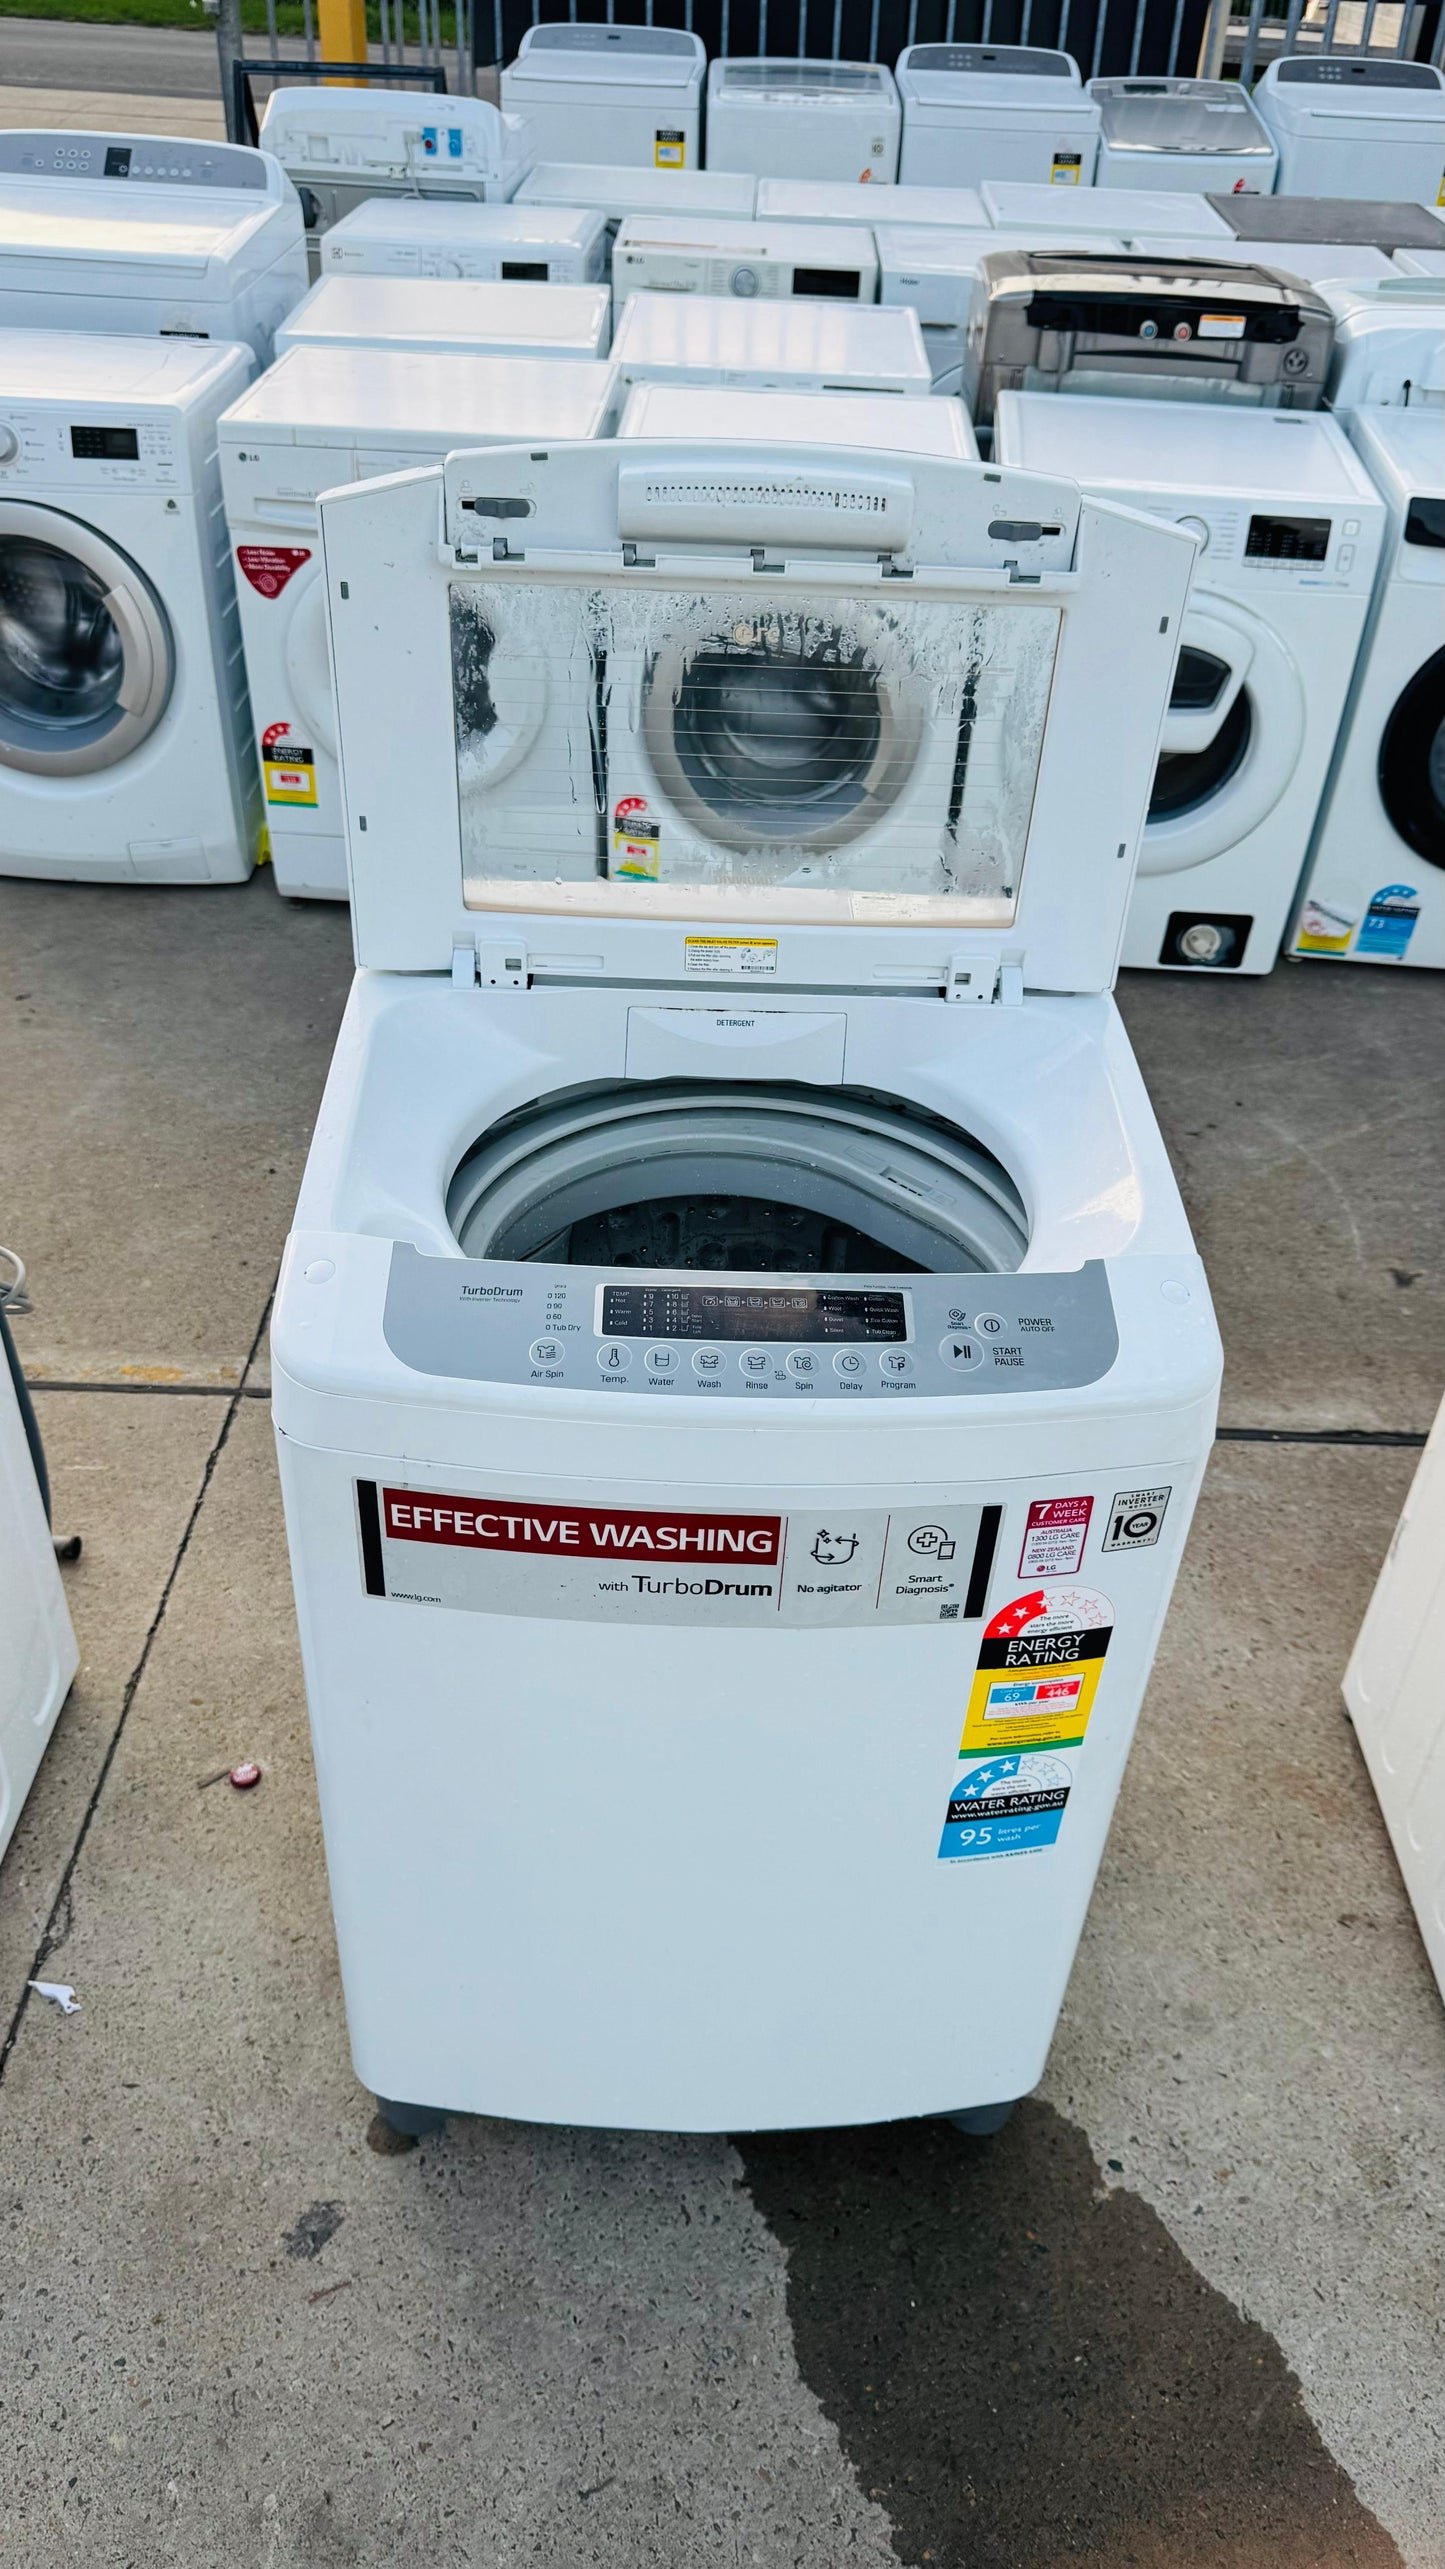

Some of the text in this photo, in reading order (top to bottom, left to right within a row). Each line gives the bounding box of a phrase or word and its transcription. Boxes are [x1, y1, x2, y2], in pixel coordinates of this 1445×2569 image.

[271, 747, 304, 757] ENERGY
[272, 755, 304, 764] RATING
[716, 1019, 755, 1027] DETERGENT
[461, 1285, 523, 1297] TurboDrum
[649, 1316, 654, 1324] 3
[1018, 1318, 1052, 1326] POWER
[567, 1324, 581, 1332] Dry
[993, 1347, 1022, 1356] START
[994, 1358, 1025, 1367] PAUSE
[531, 1370, 564, 1379] Air Spin
[601, 1374, 629, 1384] Temp.
[649, 1377, 675, 1386] Water
[697, 1379, 721, 1389] Wash
[746, 1381, 768, 1390] Rinse
[795, 1382, 814, 1391] Spin
[840, 1381, 863, 1391] Delay
[881, 1381, 916, 1390] Program
[1055, 1500, 1079, 1510] DAYS
[1118, 1494, 1165, 1506] INVERTER
[1035, 1503, 1053, 1521] 7
[1053, 1508, 1087, 1518] WEEK
[1031, 1516, 1086, 1528] CUSTOMER CARE
[1112, 1512, 1157, 1541] 10
[391, 1503, 773, 1553] EFFECTIVE WASHING
[1041, 1527, 1073, 1535] AUSTRALIA
[1031, 1535, 1048, 1543] 1300
[1049, 1533, 1059, 1541] LG
[1060, 1531, 1081, 1539] CARE
[1046, 1544, 1075, 1552] ZEALAND
[1027, 1552, 1045, 1560] 0800
[1057, 1549, 1078, 1557] CARE
[908, 1575, 943, 1584] Smart
[598, 1575, 772, 1596] with TurboDrum
[797, 1583, 862, 1595] No agitator
[391, 1592, 441, 1603] www.lg.com
[1007, 1633, 1086, 1653] ENERGY
[1005, 1648, 1080, 1666] RATING
[1004, 1692, 1020, 1702] 69
[1046, 1687, 1070, 1698] 446
[954, 1790, 1065, 1812] WATER RATING
[951, 1801, 1063, 1819] www.waterrating.gov.au
[1024, 1824, 1041, 1832] per
[960, 1827, 993, 1846] 95
